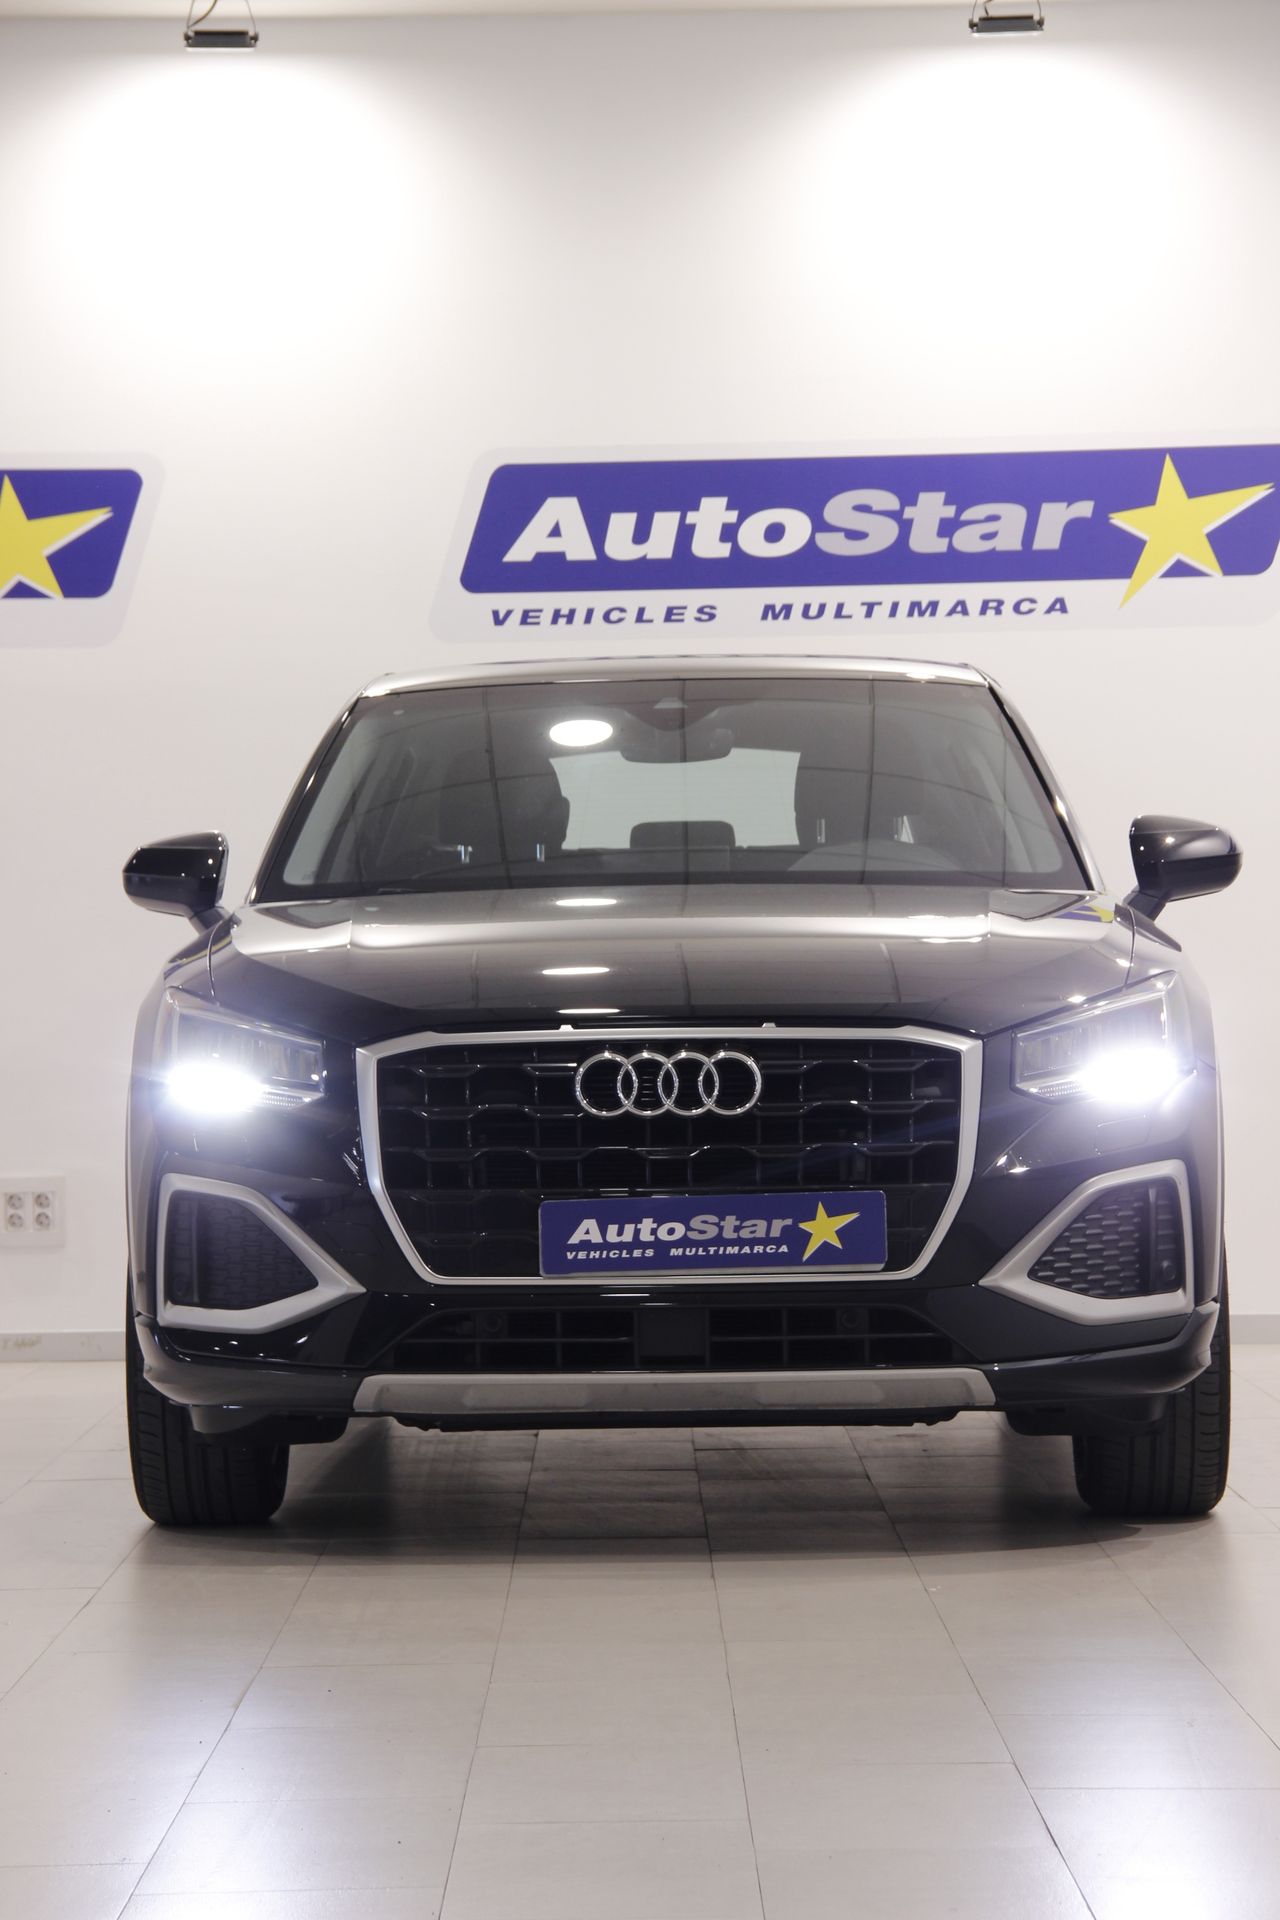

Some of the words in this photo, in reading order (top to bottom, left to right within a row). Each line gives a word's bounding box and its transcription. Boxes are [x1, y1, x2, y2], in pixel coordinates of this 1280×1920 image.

[502, 488, 1095, 563] AutoStar
[490, 604, 719, 627] VEHICLES
[760, 596, 1071, 622] MULTIMARCA
[567, 1214, 793, 1244] AutoStar
[566, 1249, 655, 1260] VEHICLES
[670, 1245, 789, 1256] MULTIMARCA
